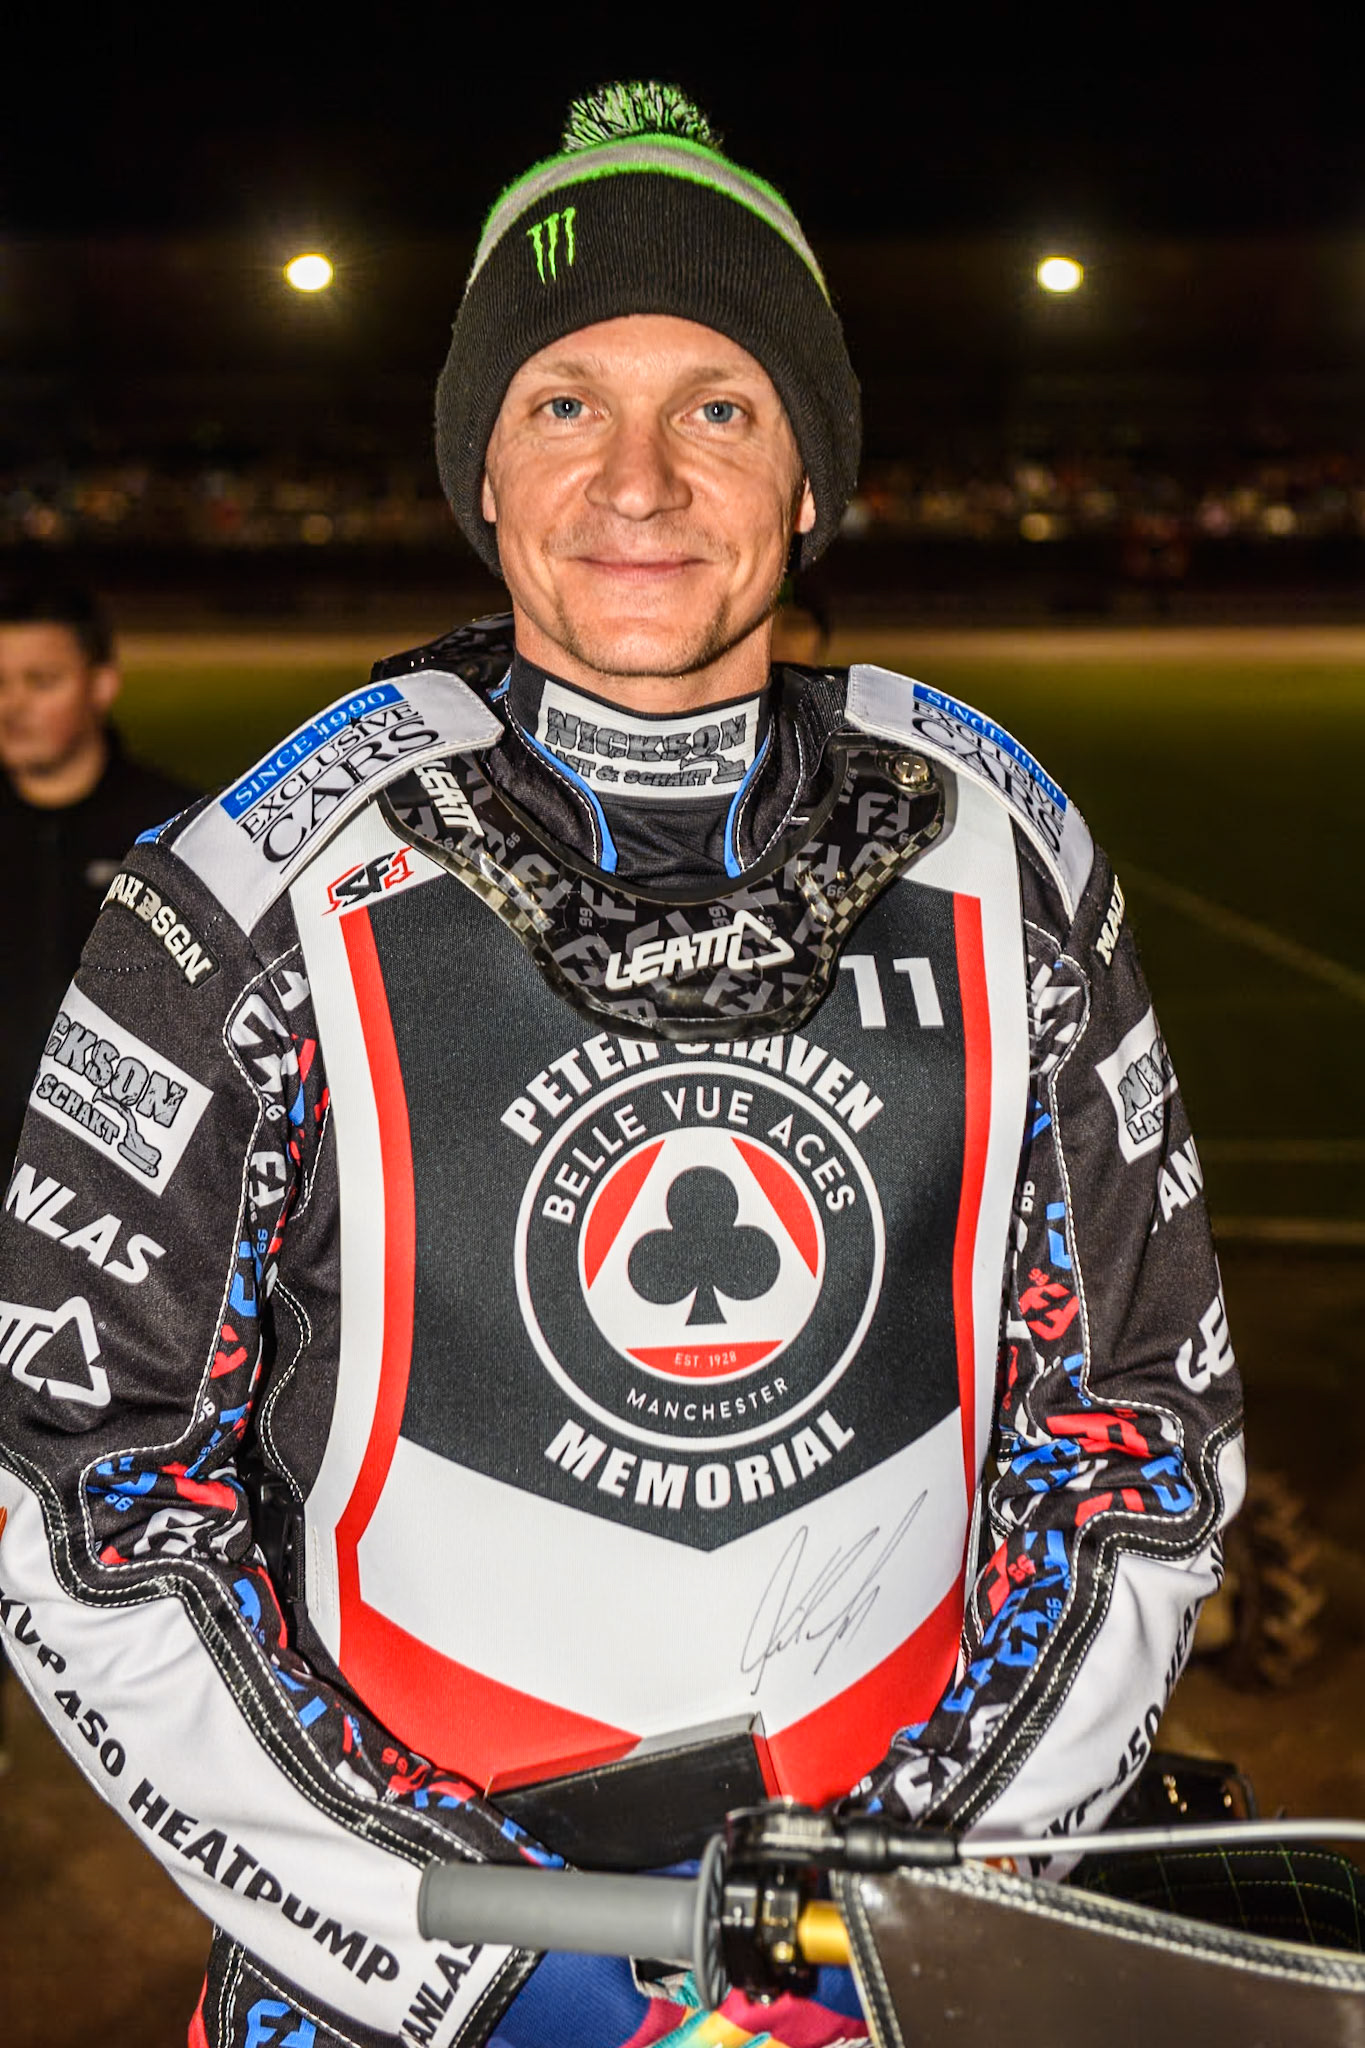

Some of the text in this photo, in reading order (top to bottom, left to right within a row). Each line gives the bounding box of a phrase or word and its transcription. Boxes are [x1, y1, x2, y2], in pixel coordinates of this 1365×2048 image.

[235, 691, 386, 806] SINCE 1990
[240, 704, 419, 839] EXCLUSIVE
[544, 706, 747, 762] NICKSON
[596, 765, 619, 782] &
[624, 768, 711, 786] SCHAKT
[912, 717, 1062, 853] CARS
[913, 700, 1065, 823] EXCLUSIVE
[926, 691, 1058, 799] SINCE 1990
[263, 719, 439, 863] CARS
[605, 921, 740, 990] LEATT
[838, 954, 944, 1030] 11
[36, 1073, 120, 1145] SCHAKT
[500, 1032, 884, 1145] PETER AVEN
[542, 1086, 856, 1225] BELLE VUE ACES
[7, 1162, 167, 1284] NLAS
[626, 1377, 790, 1421] MANCHESTER
[674, 1351, 737, 1367] EST 1928
[543, 1408, 856, 1510] MEMORIAL
[55, 1690, 126, 1777] 450
[129, 1779, 400, 1985] HEATPUMP
